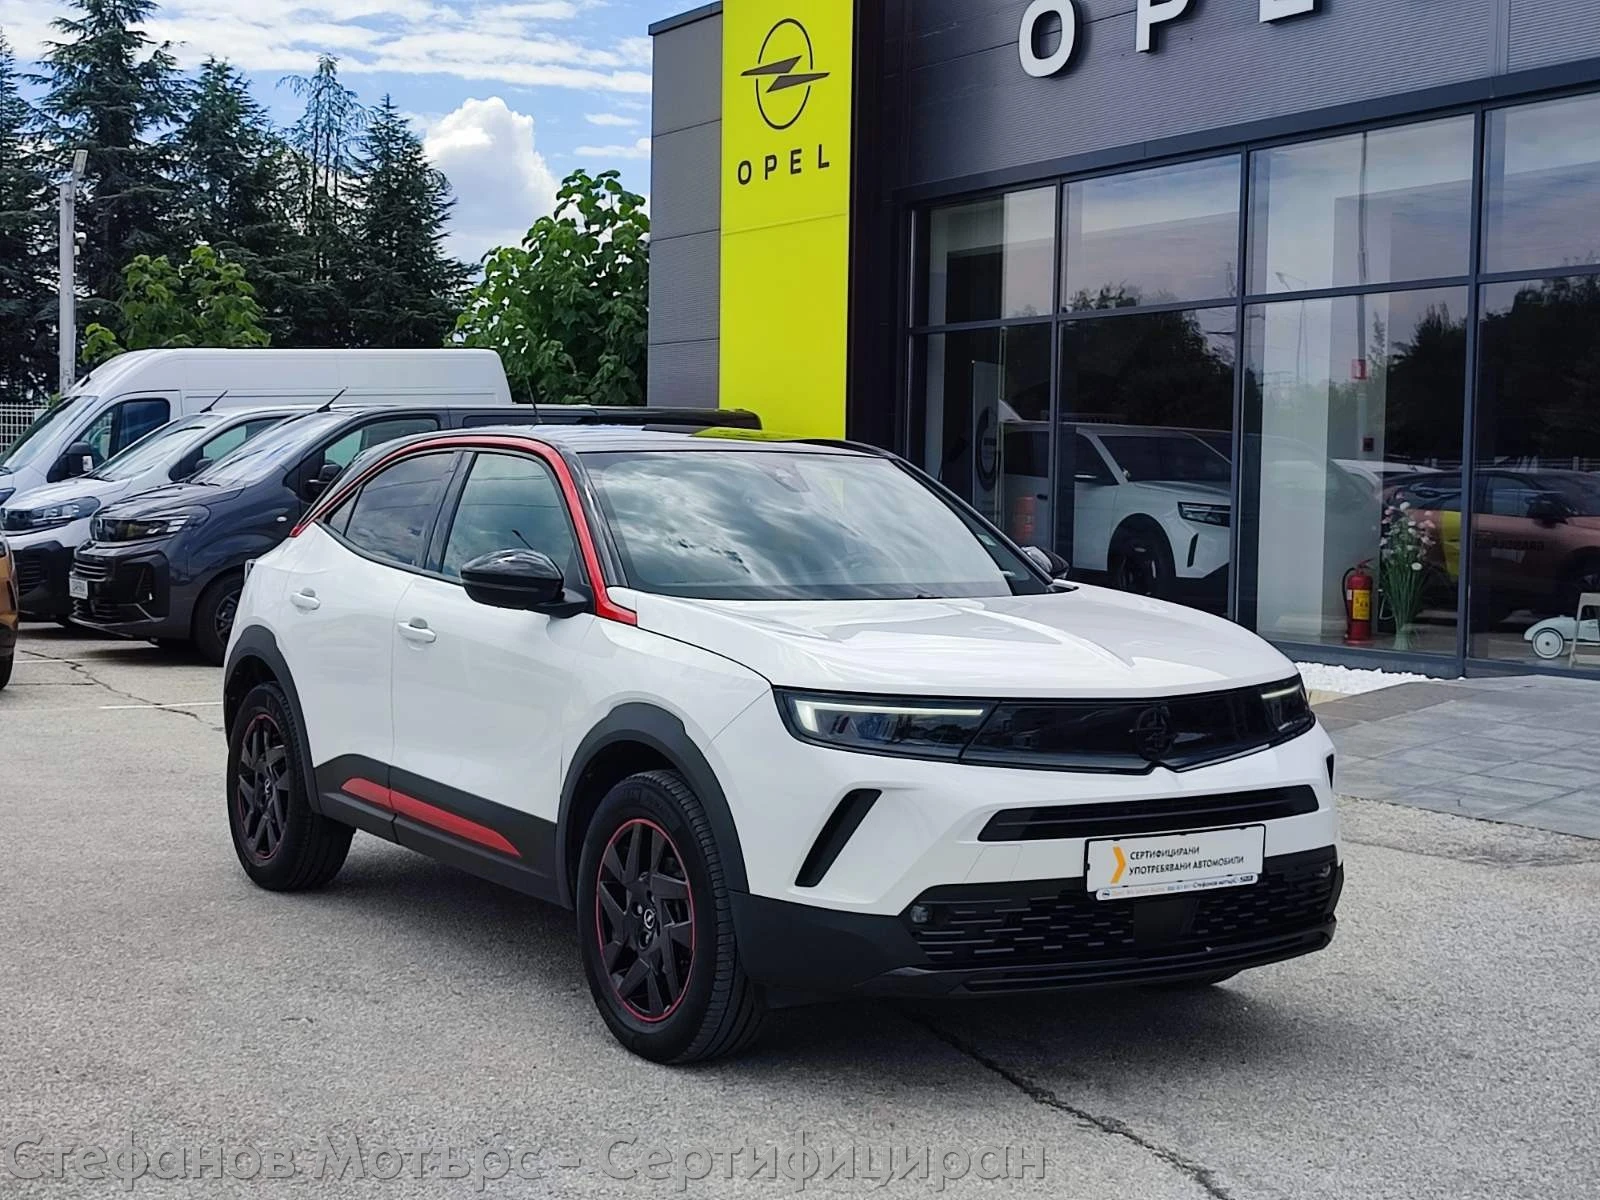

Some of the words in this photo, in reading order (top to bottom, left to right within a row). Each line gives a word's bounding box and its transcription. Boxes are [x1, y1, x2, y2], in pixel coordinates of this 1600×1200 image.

[1018, 0, 1314, 77] OP
[737, 143, 830, 185] OPEL
[1128, 862, 1192, 876] УПОТРЕБЯВАНИ
[1192, 855, 1245, 870] АВТОМОБИЛИ
[1129, 846, 1200, 861] СЕРТИФИЦИРАНИ
